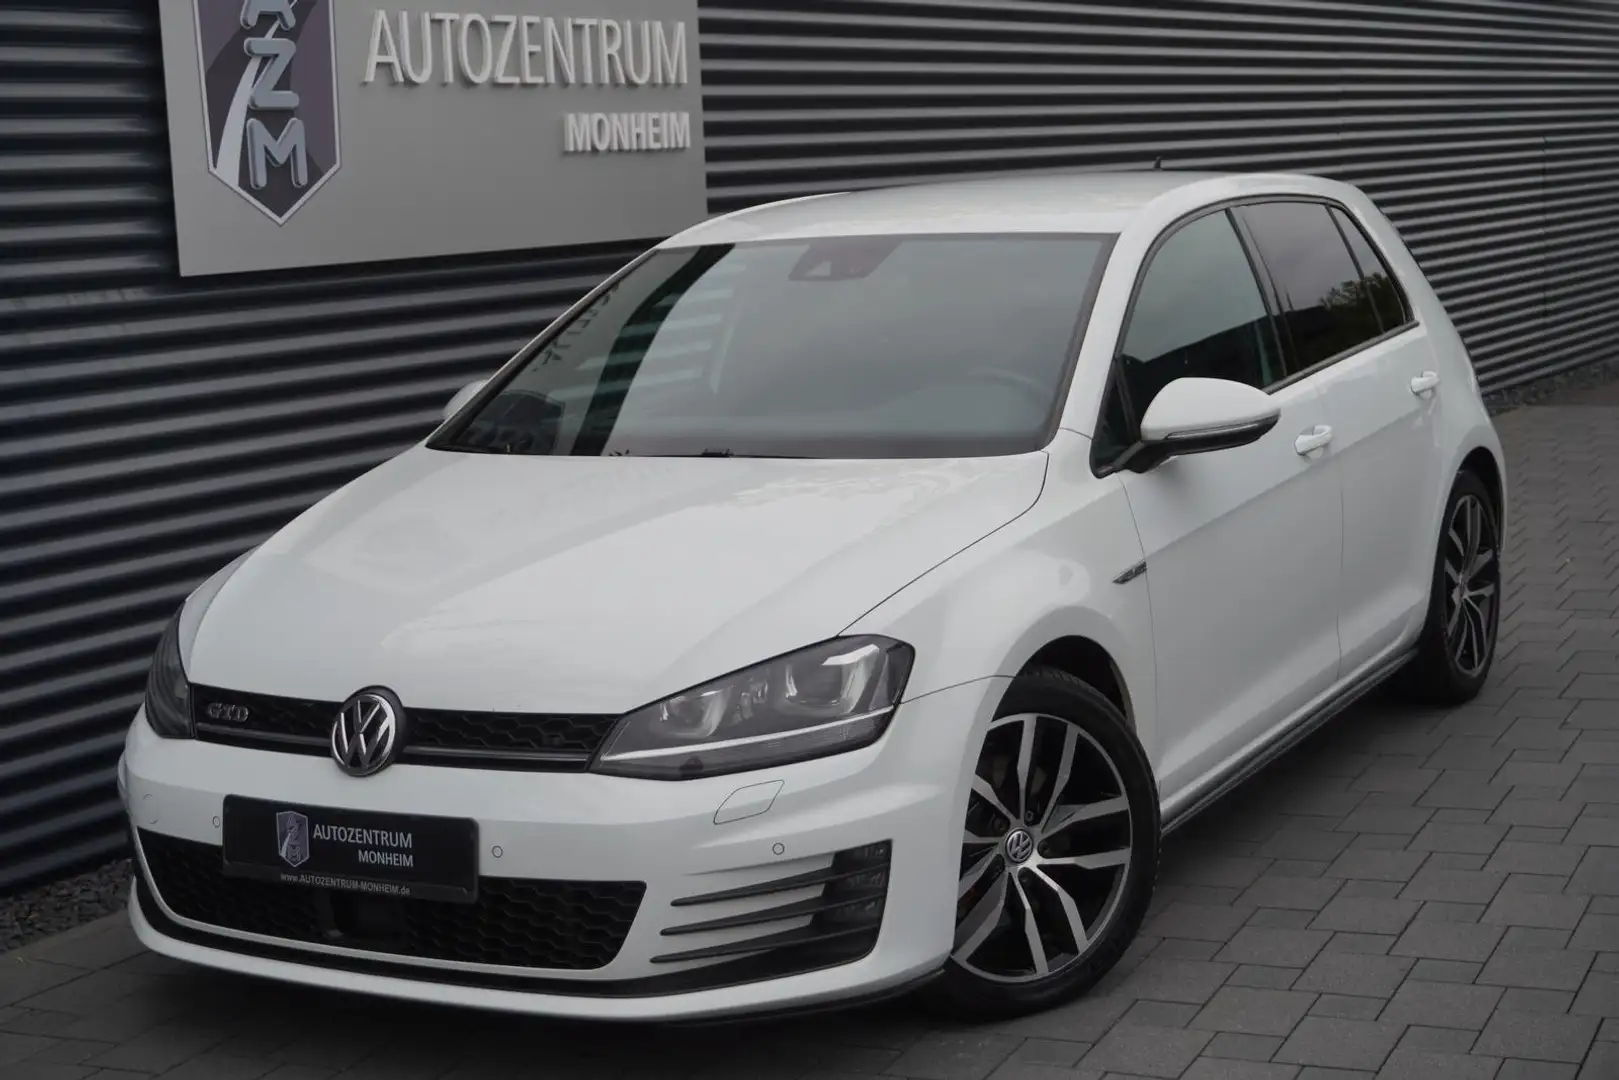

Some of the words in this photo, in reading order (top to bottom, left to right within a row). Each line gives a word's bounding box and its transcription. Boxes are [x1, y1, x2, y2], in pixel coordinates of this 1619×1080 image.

[366, 10, 688, 86] AUTOZENTRUM
[564, 112, 691, 152] MONHEIM
[313, 824, 413, 848] AUTOZENTRUM
[357, 850, 414, 867] MONHEIM
[280, 873, 411, 896] www.AUTOZENTRUM-MONHEIM.de
